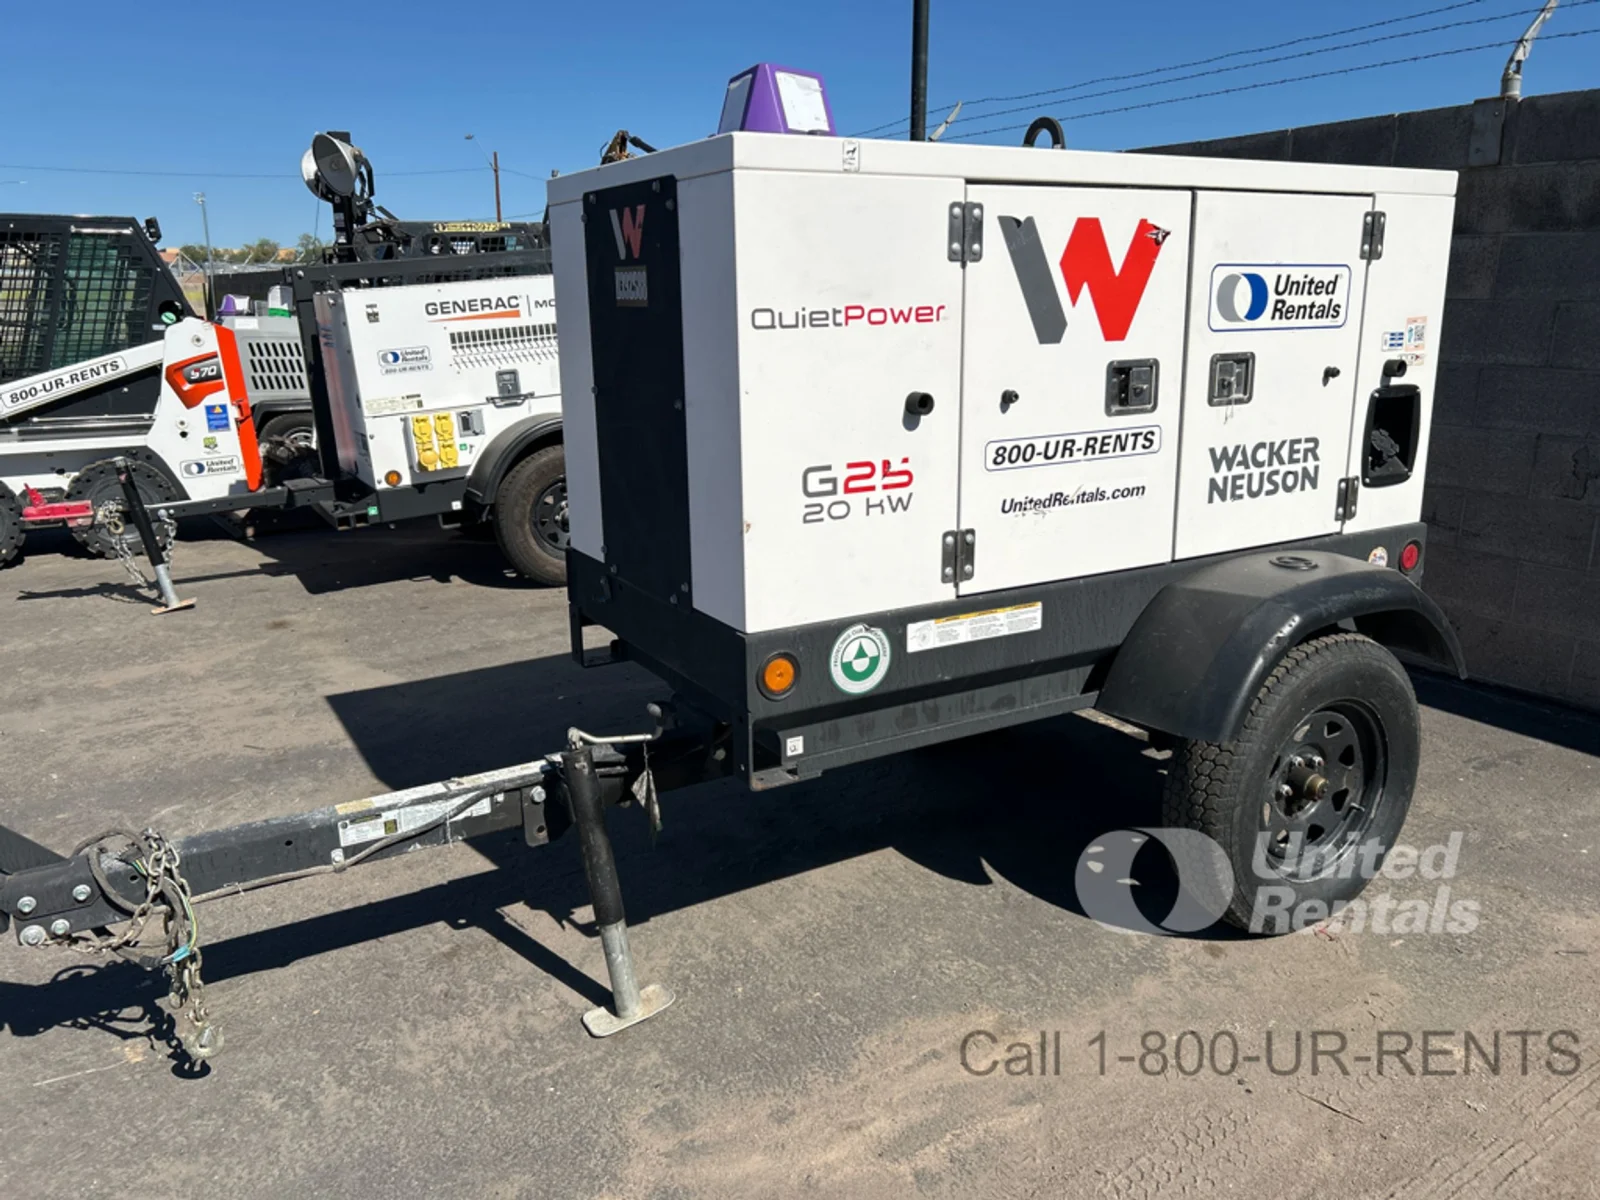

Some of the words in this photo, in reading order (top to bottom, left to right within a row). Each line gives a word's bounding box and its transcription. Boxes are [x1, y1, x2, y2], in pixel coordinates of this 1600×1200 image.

[1274, 274, 1339, 296] United
[425, 295, 520, 316] GENERAC
[751, 304, 945, 330] QuietPower
[1271, 298, 1341, 321] Rentals
[9, 360, 120, 404] 800-UR-RENTS
[992, 430, 1155, 466] 800-UR-RENTS
[1208, 437, 1320, 474] WACKER
[206, 458, 234, 467] United
[207, 465, 237, 473] Rentals
[802, 457, 914, 498] G25
[1208, 464, 1320, 504] NEUSON
[802, 500, 851, 524] 20
[1001, 485, 1146, 514] UnitedRentals.com
